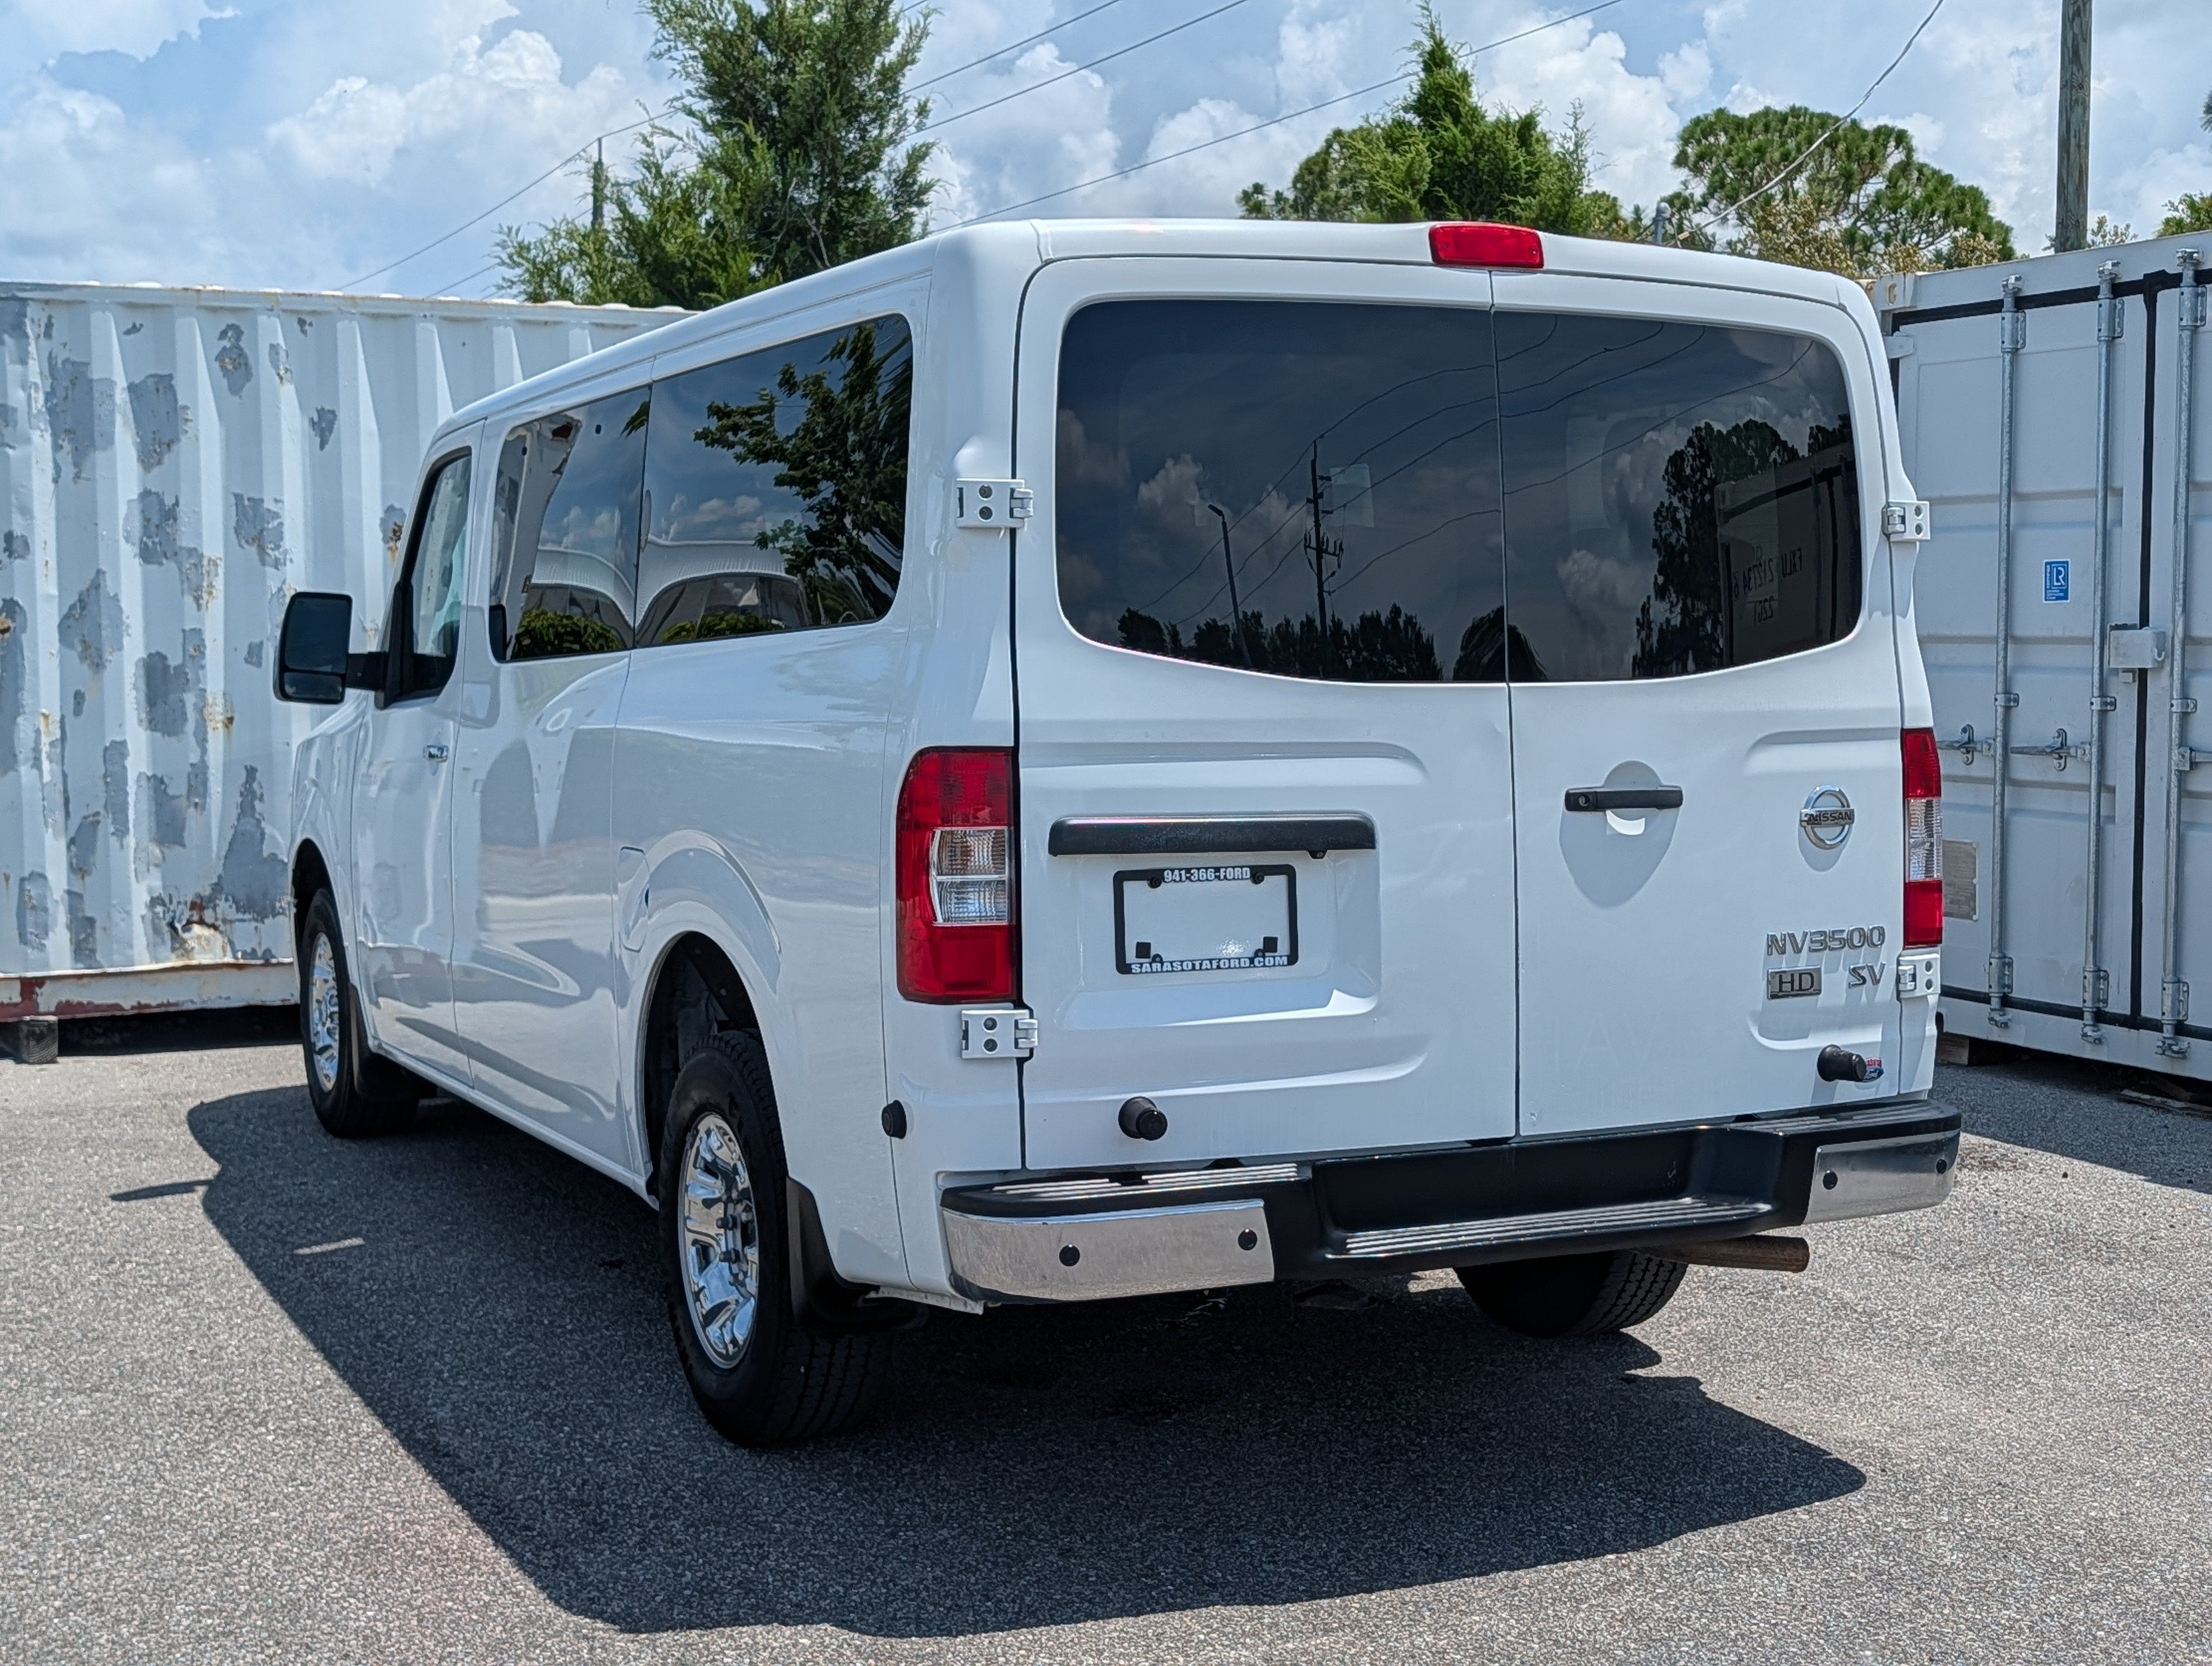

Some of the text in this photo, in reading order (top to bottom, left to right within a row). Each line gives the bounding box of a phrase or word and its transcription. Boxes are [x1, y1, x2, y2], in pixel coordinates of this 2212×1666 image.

[1809, 811, 1851, 822] NISSAN
[1163, 868, 1251, 882] 941-366-FORD
[1766, 924, 1886, 956] NV3500
[1131, 957, 1288, 974] SARASOTAFORD.COM
[1778, 961, 1887, 993] HD SV
